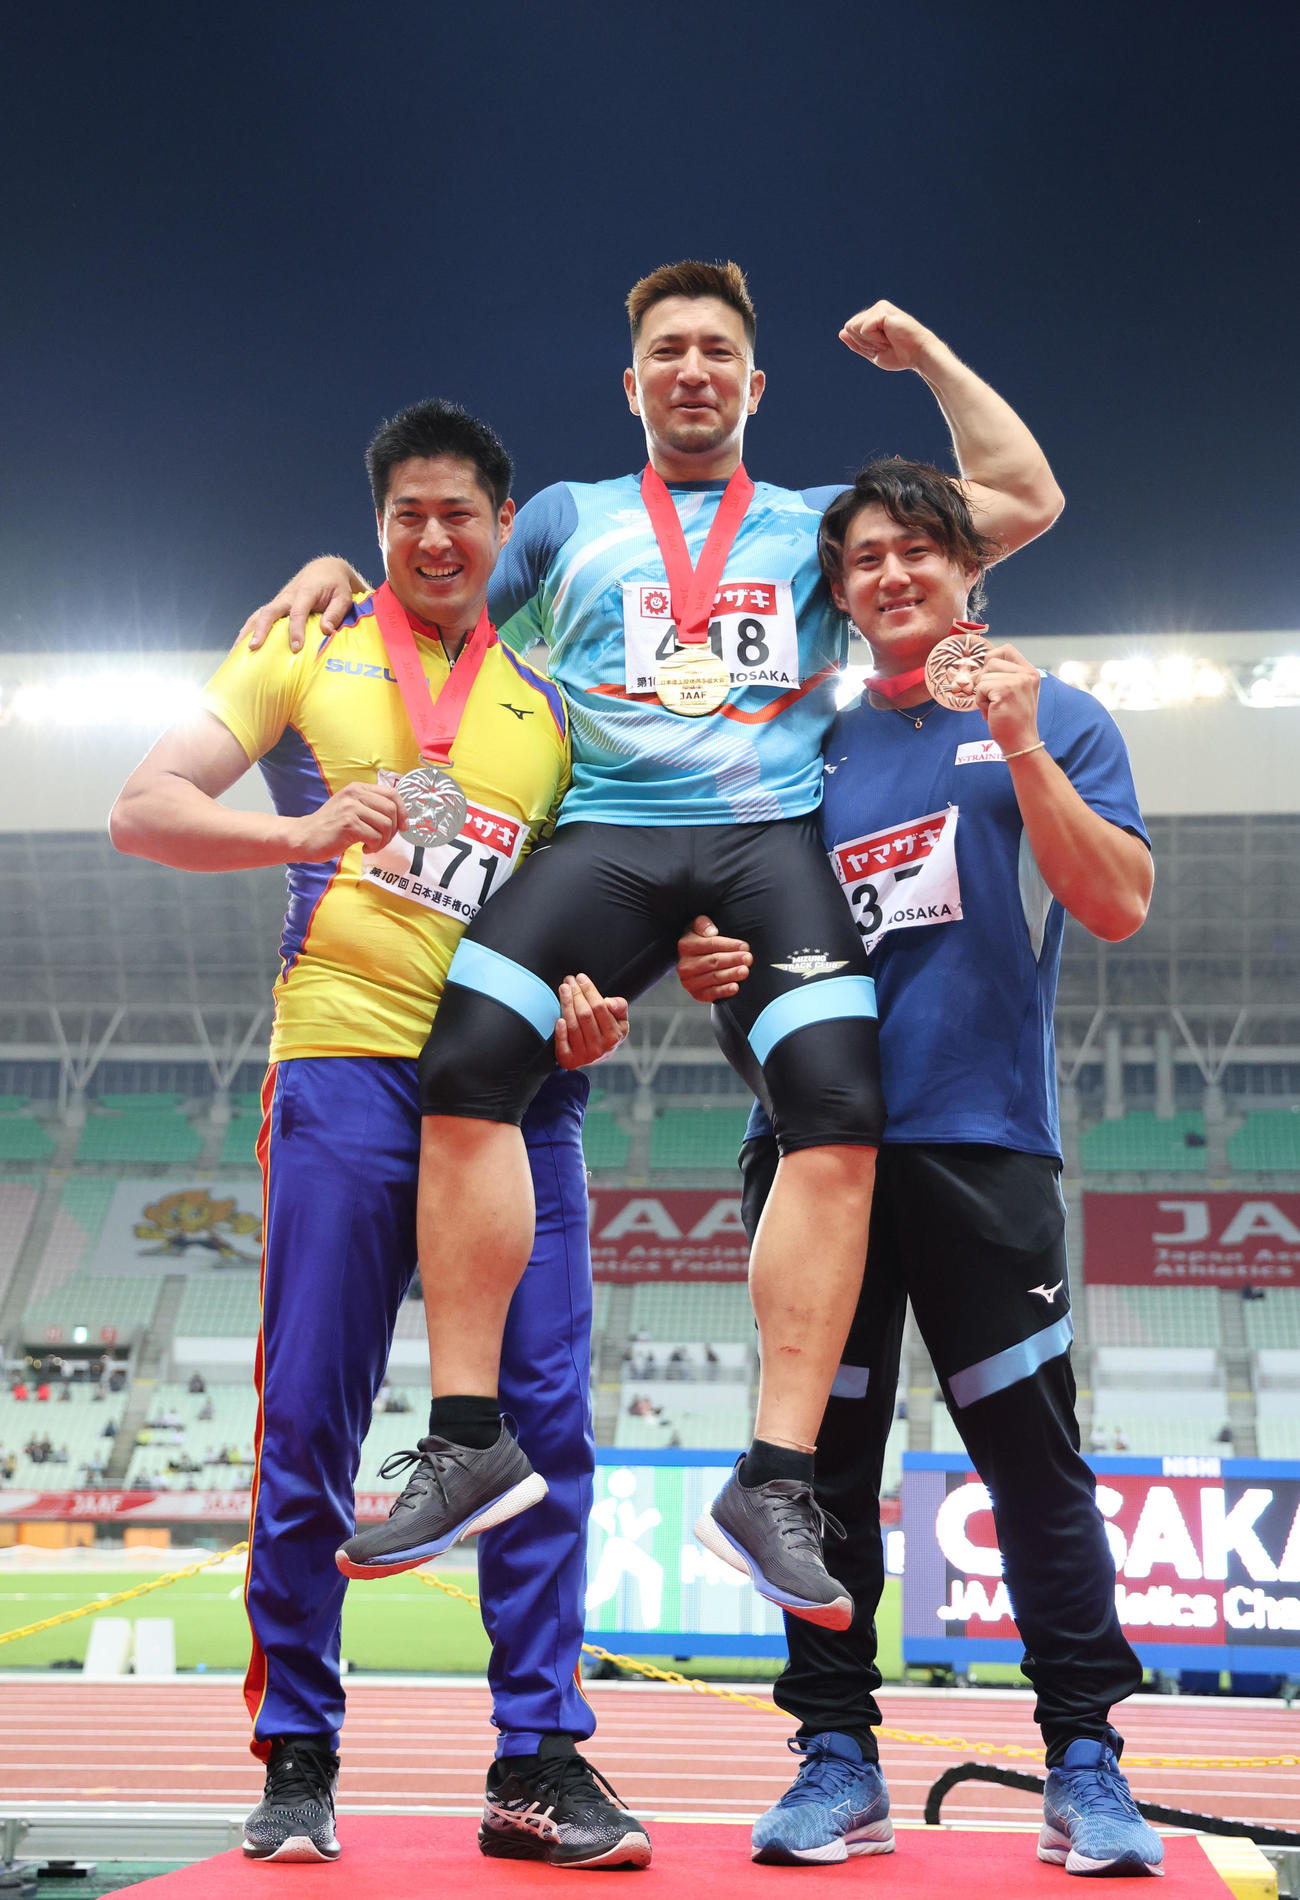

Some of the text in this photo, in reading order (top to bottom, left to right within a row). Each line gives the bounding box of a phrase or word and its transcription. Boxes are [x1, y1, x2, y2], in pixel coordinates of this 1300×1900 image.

[714, 589, 769, 608] ザキ
[655, 618, 769, 667] 418
[325, 658, 398, 683] SUZU
[680, 691, 707, 700] JAAF
[465, 813, 515, 847] ザキ
[847, 828, 940, 873] ヤマザキ
[370, 867, 477, 920] 第107回 日本選手権OS
[409, 838, 499, 907] 171
[1152, 1200, 1300, 1244] JA
[1153, 1263, 1293, 1277] Athletics
[937, 1579, 1017, 1622] JAA
[1114, 1583, 1219, 1628] letics
